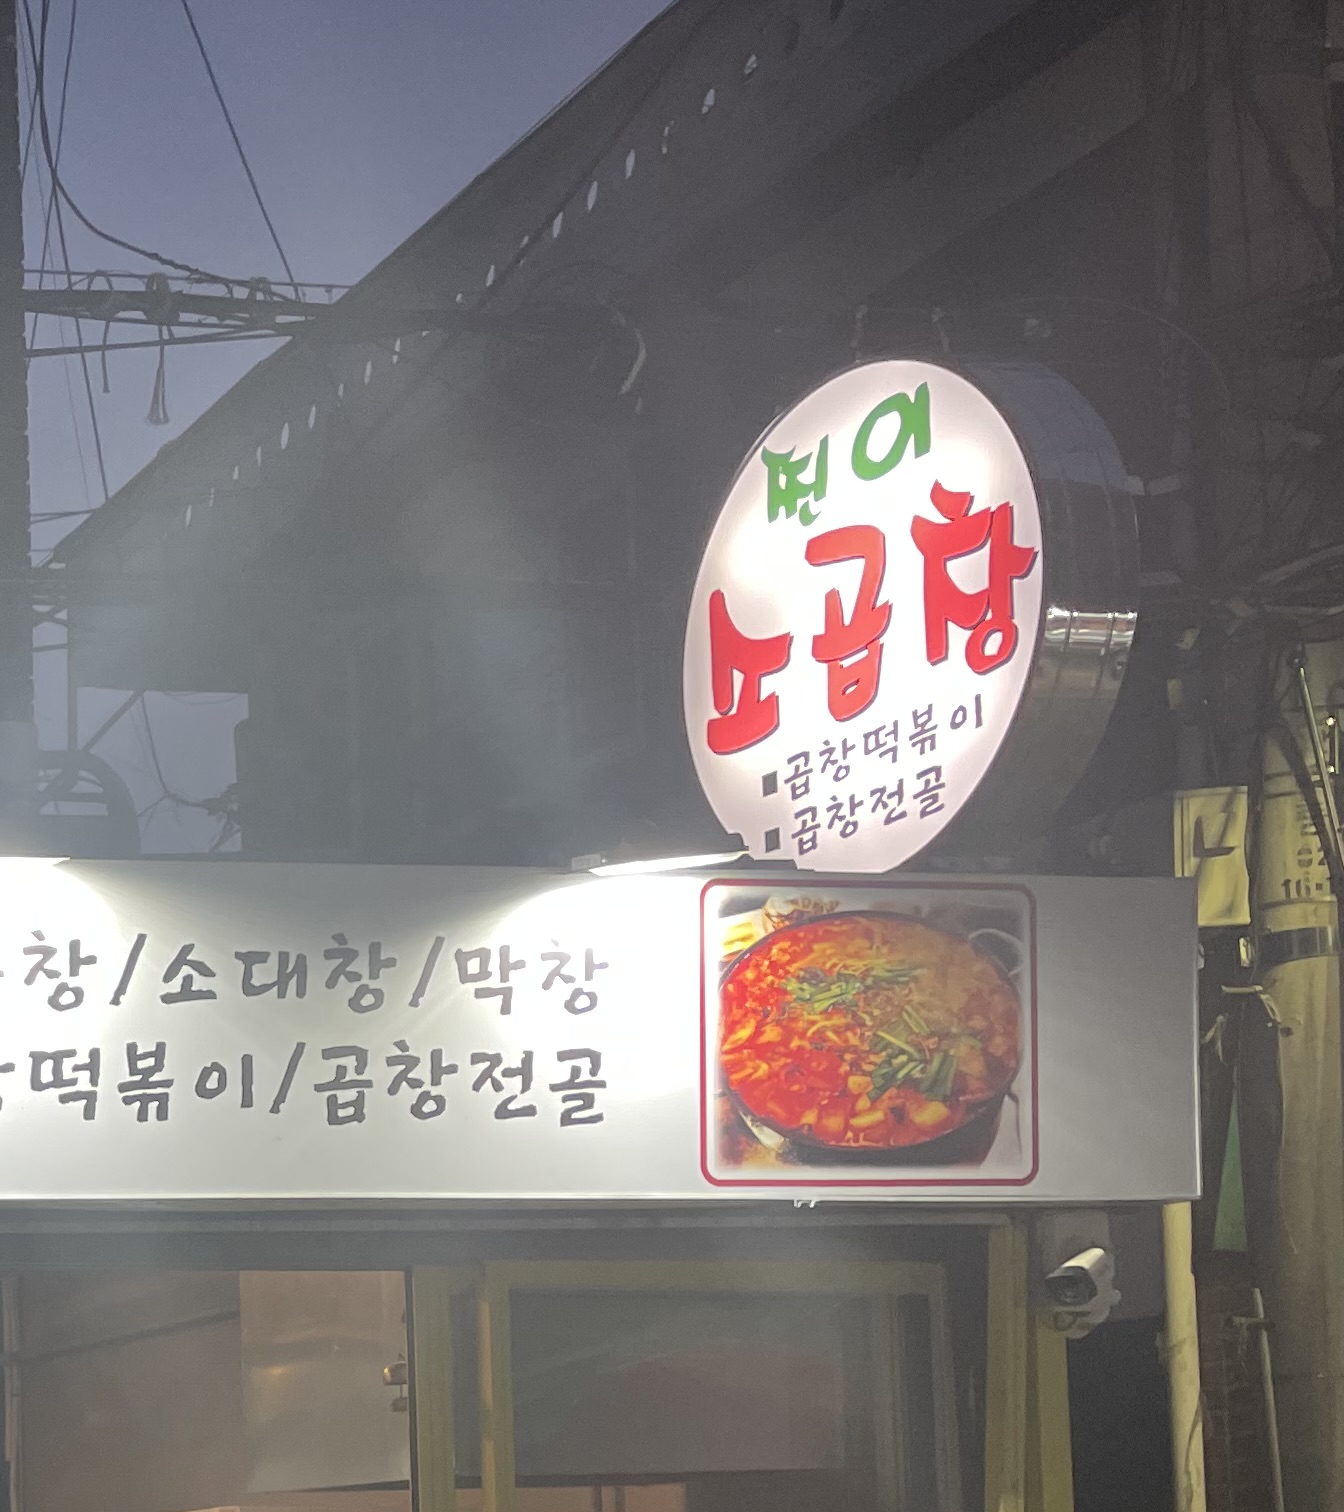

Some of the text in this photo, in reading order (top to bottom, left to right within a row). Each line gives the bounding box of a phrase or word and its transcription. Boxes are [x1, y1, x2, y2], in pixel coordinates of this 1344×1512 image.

[707, 480, 1039, 755] 소곱창
[784, 694, 983, 801] 곱창떡볶이
[791, 765, 946, 855] 곱창전골
